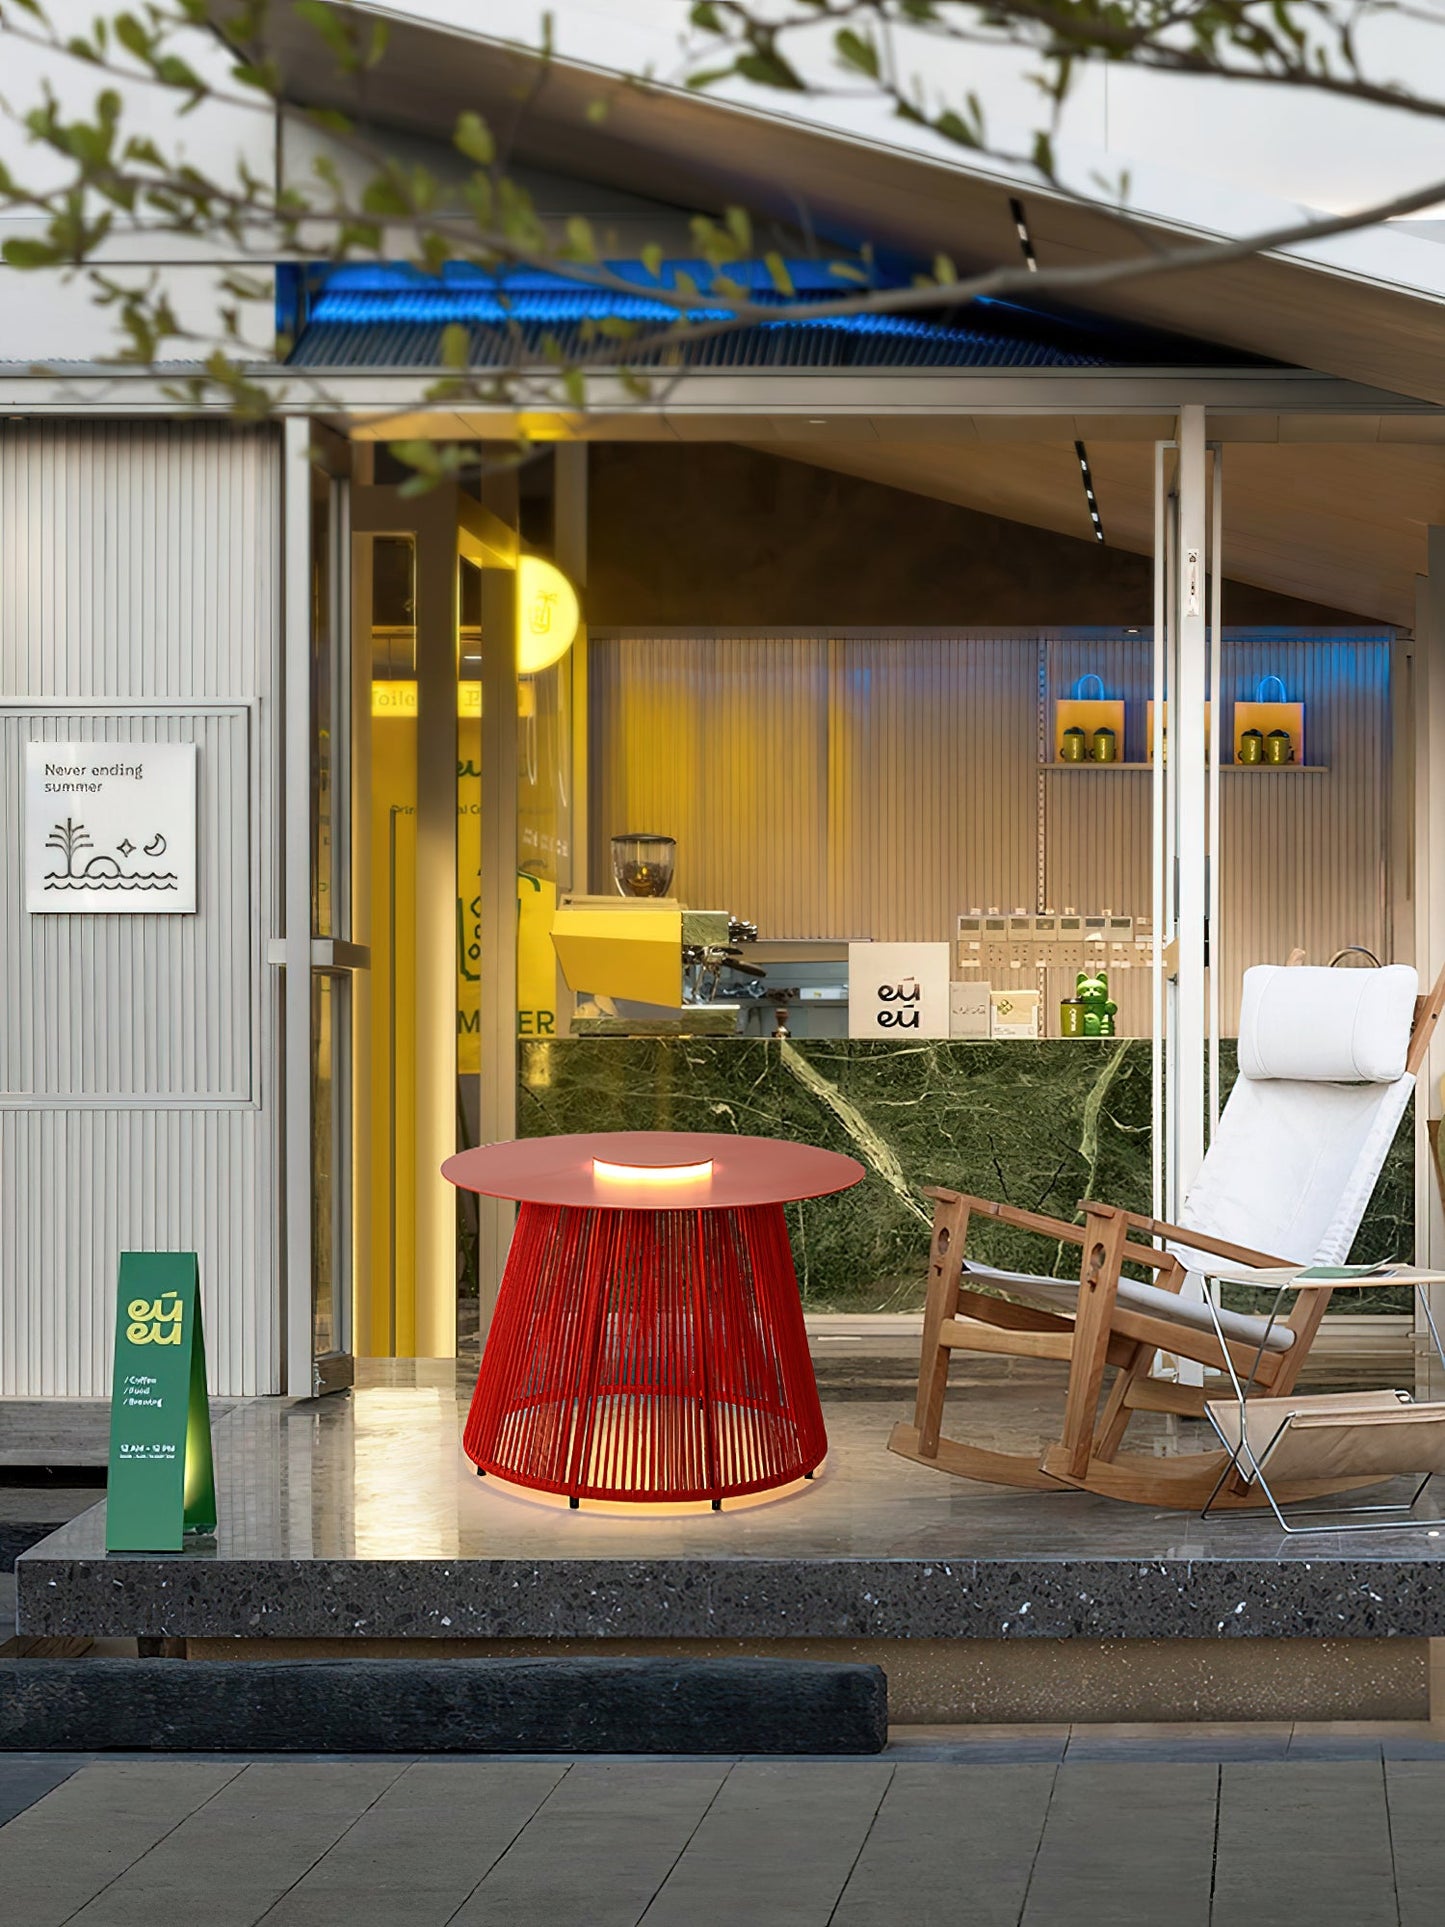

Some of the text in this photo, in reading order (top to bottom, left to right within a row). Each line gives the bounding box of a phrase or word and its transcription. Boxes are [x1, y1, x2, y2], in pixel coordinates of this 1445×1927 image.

[373, 690, 416, 706] oile
[45, 764, 143, 780] Never ending
[45, 783, 102, 792] summer
